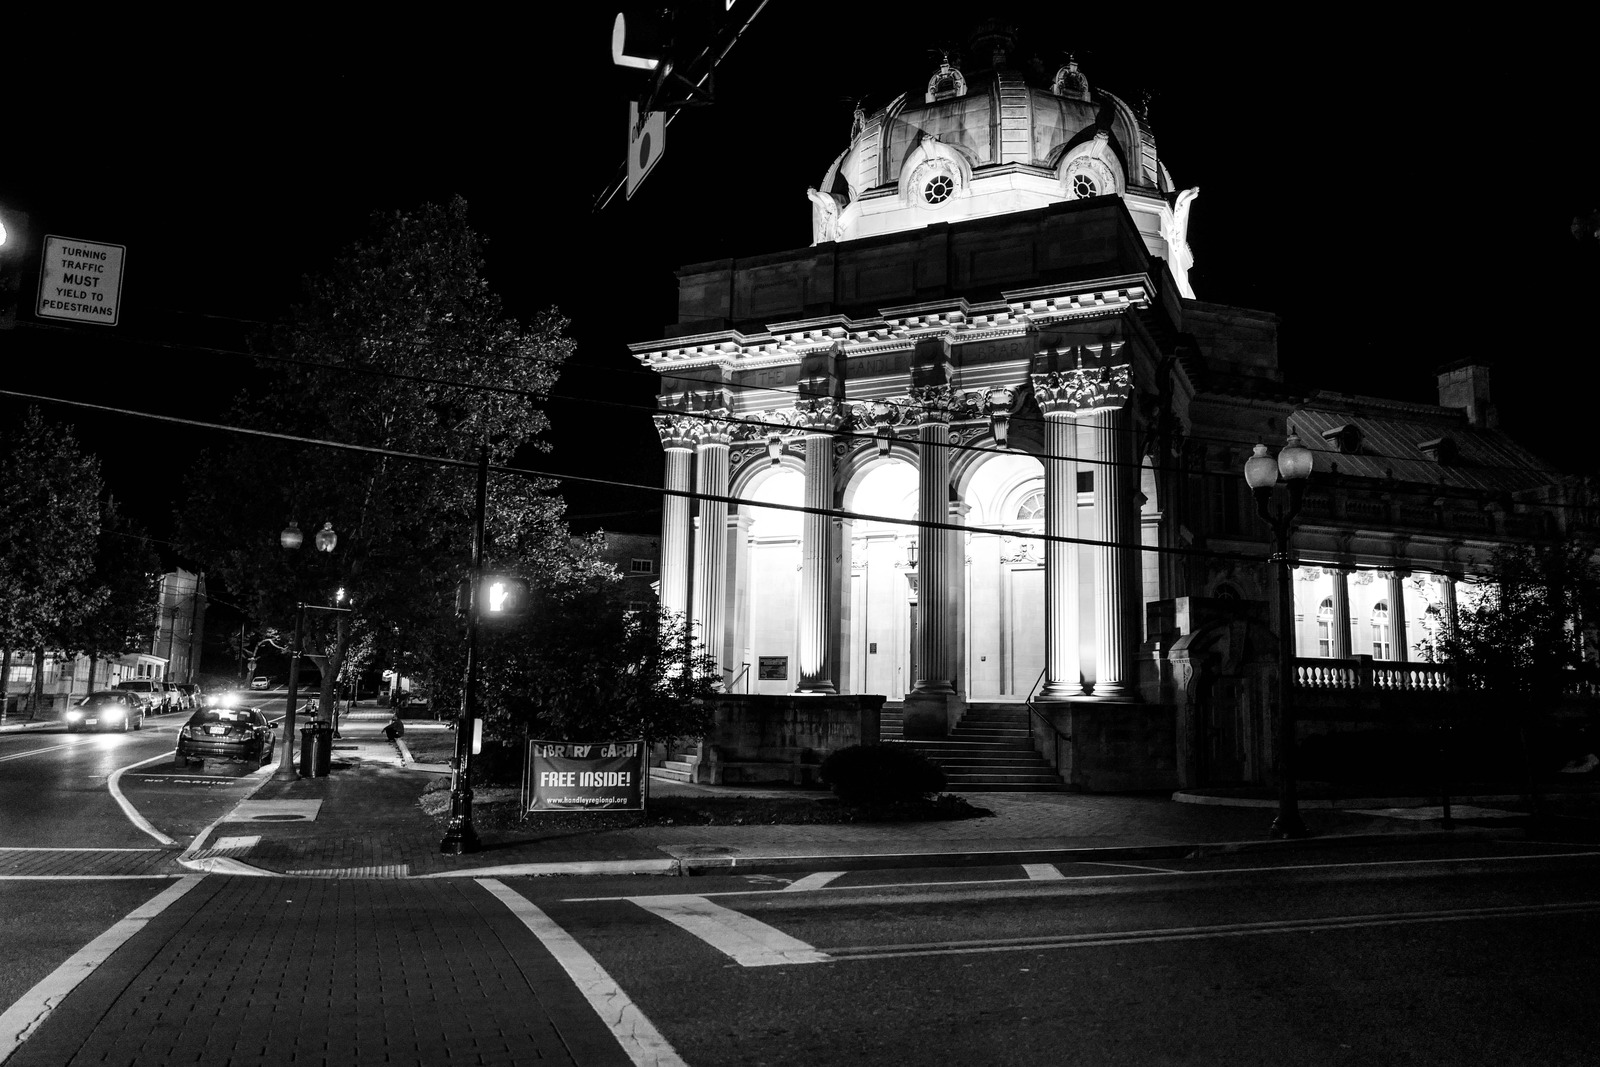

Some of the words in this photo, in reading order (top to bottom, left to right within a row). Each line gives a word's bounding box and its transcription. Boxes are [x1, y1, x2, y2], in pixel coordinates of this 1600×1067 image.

[62, 246, 107, 260] TURNING
[62, 259, 104, 273] TRAFFIC
[63, 273, 100, 287] MUST
[56, 287, 87, 299] YIELD
[91, 292, 104, 301] TO
[42, 299, 113, 315] PEDESTRIANS
[540, 771, 576, 787] FREE
[579, 771, 631, 787] INSIDE!
[546, 796, 628, 805] www.handleyregional.org
